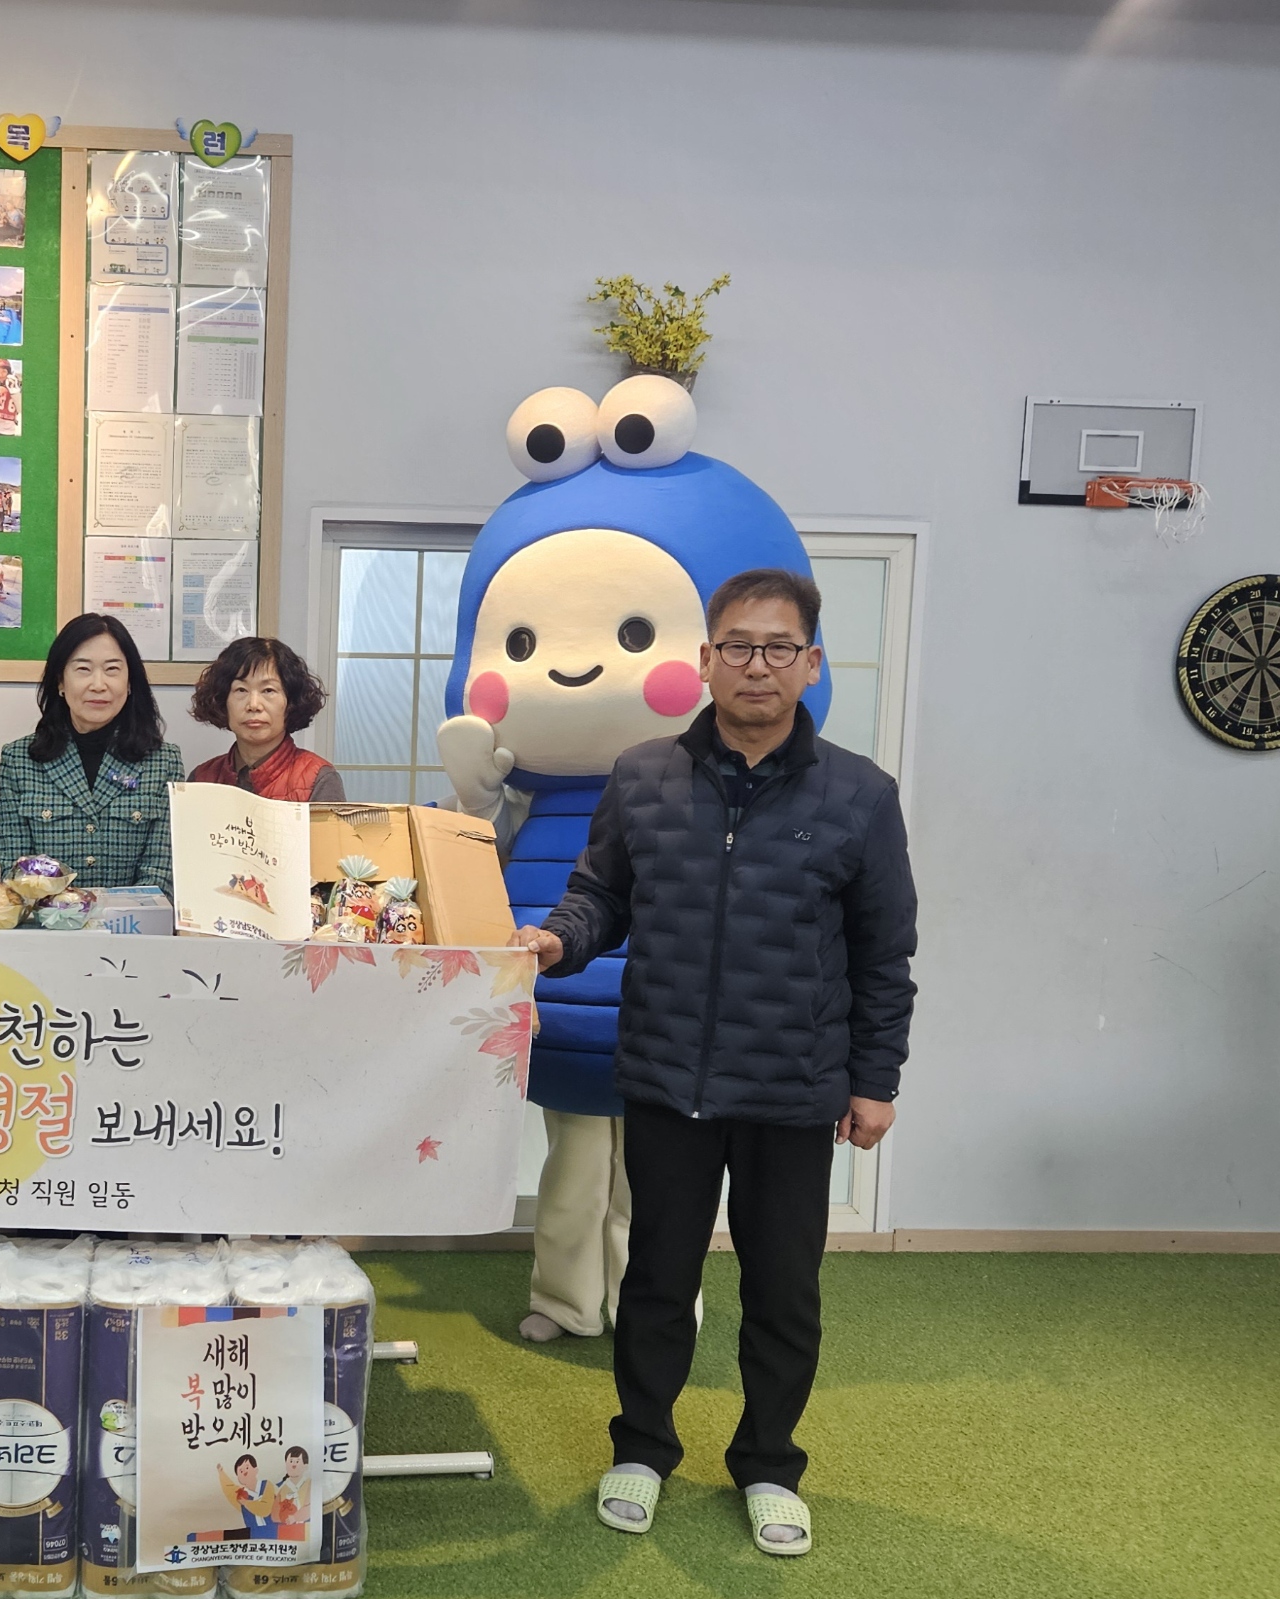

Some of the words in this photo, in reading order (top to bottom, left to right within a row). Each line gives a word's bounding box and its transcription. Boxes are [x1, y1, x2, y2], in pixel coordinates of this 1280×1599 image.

[6, 123, 31, 151] 목
[203, 129, 226, 157] 련
[1249, 589, 1261, 599] 20
[1210, 607, 1223, 620] 12
[90, 1101, 284, 1157] 보내세요!
[30, 1178, 77, 1206] 직원
[87, 1181, 136, 1209] 일동
[202, 1333, 250, 1372] 새해
[180, 1372, 206, 1410] 복
[211, 1372, 258, 1411] 많이
[180, 1412, 284, 1451] 받으세요!
[45, 1538, 67, 1549] 07046
[190, 1542, 298, 1556] 경상남도창녕교육지원청
[191, 1555, 232, 1564] CHANGNYEONG
[234, 1555, 254, 1563] OFFICE
[265, 1554, 297, 1563] EDUCATION
